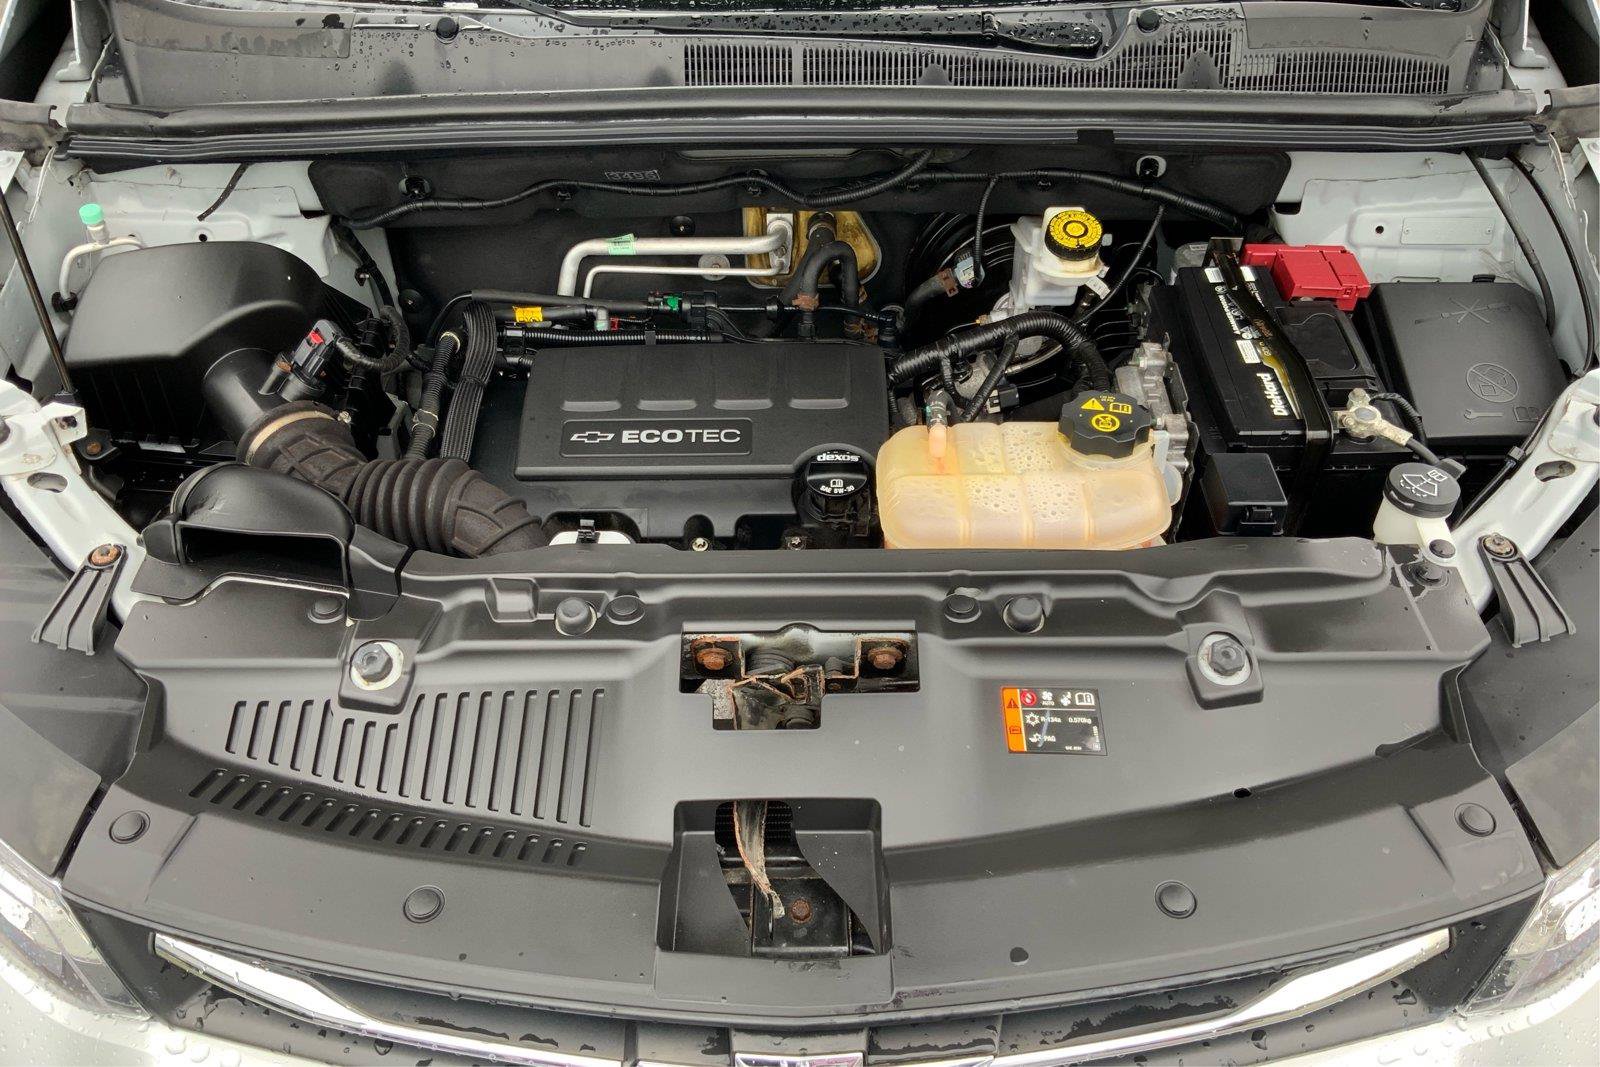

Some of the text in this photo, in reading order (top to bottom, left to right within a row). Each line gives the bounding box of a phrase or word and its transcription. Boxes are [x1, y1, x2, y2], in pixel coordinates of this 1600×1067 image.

[1257, 372, 1290, 416] DieHard
[621, 429, 741, 444] ECOTEC
[816, 453, 860, 462] dexos
